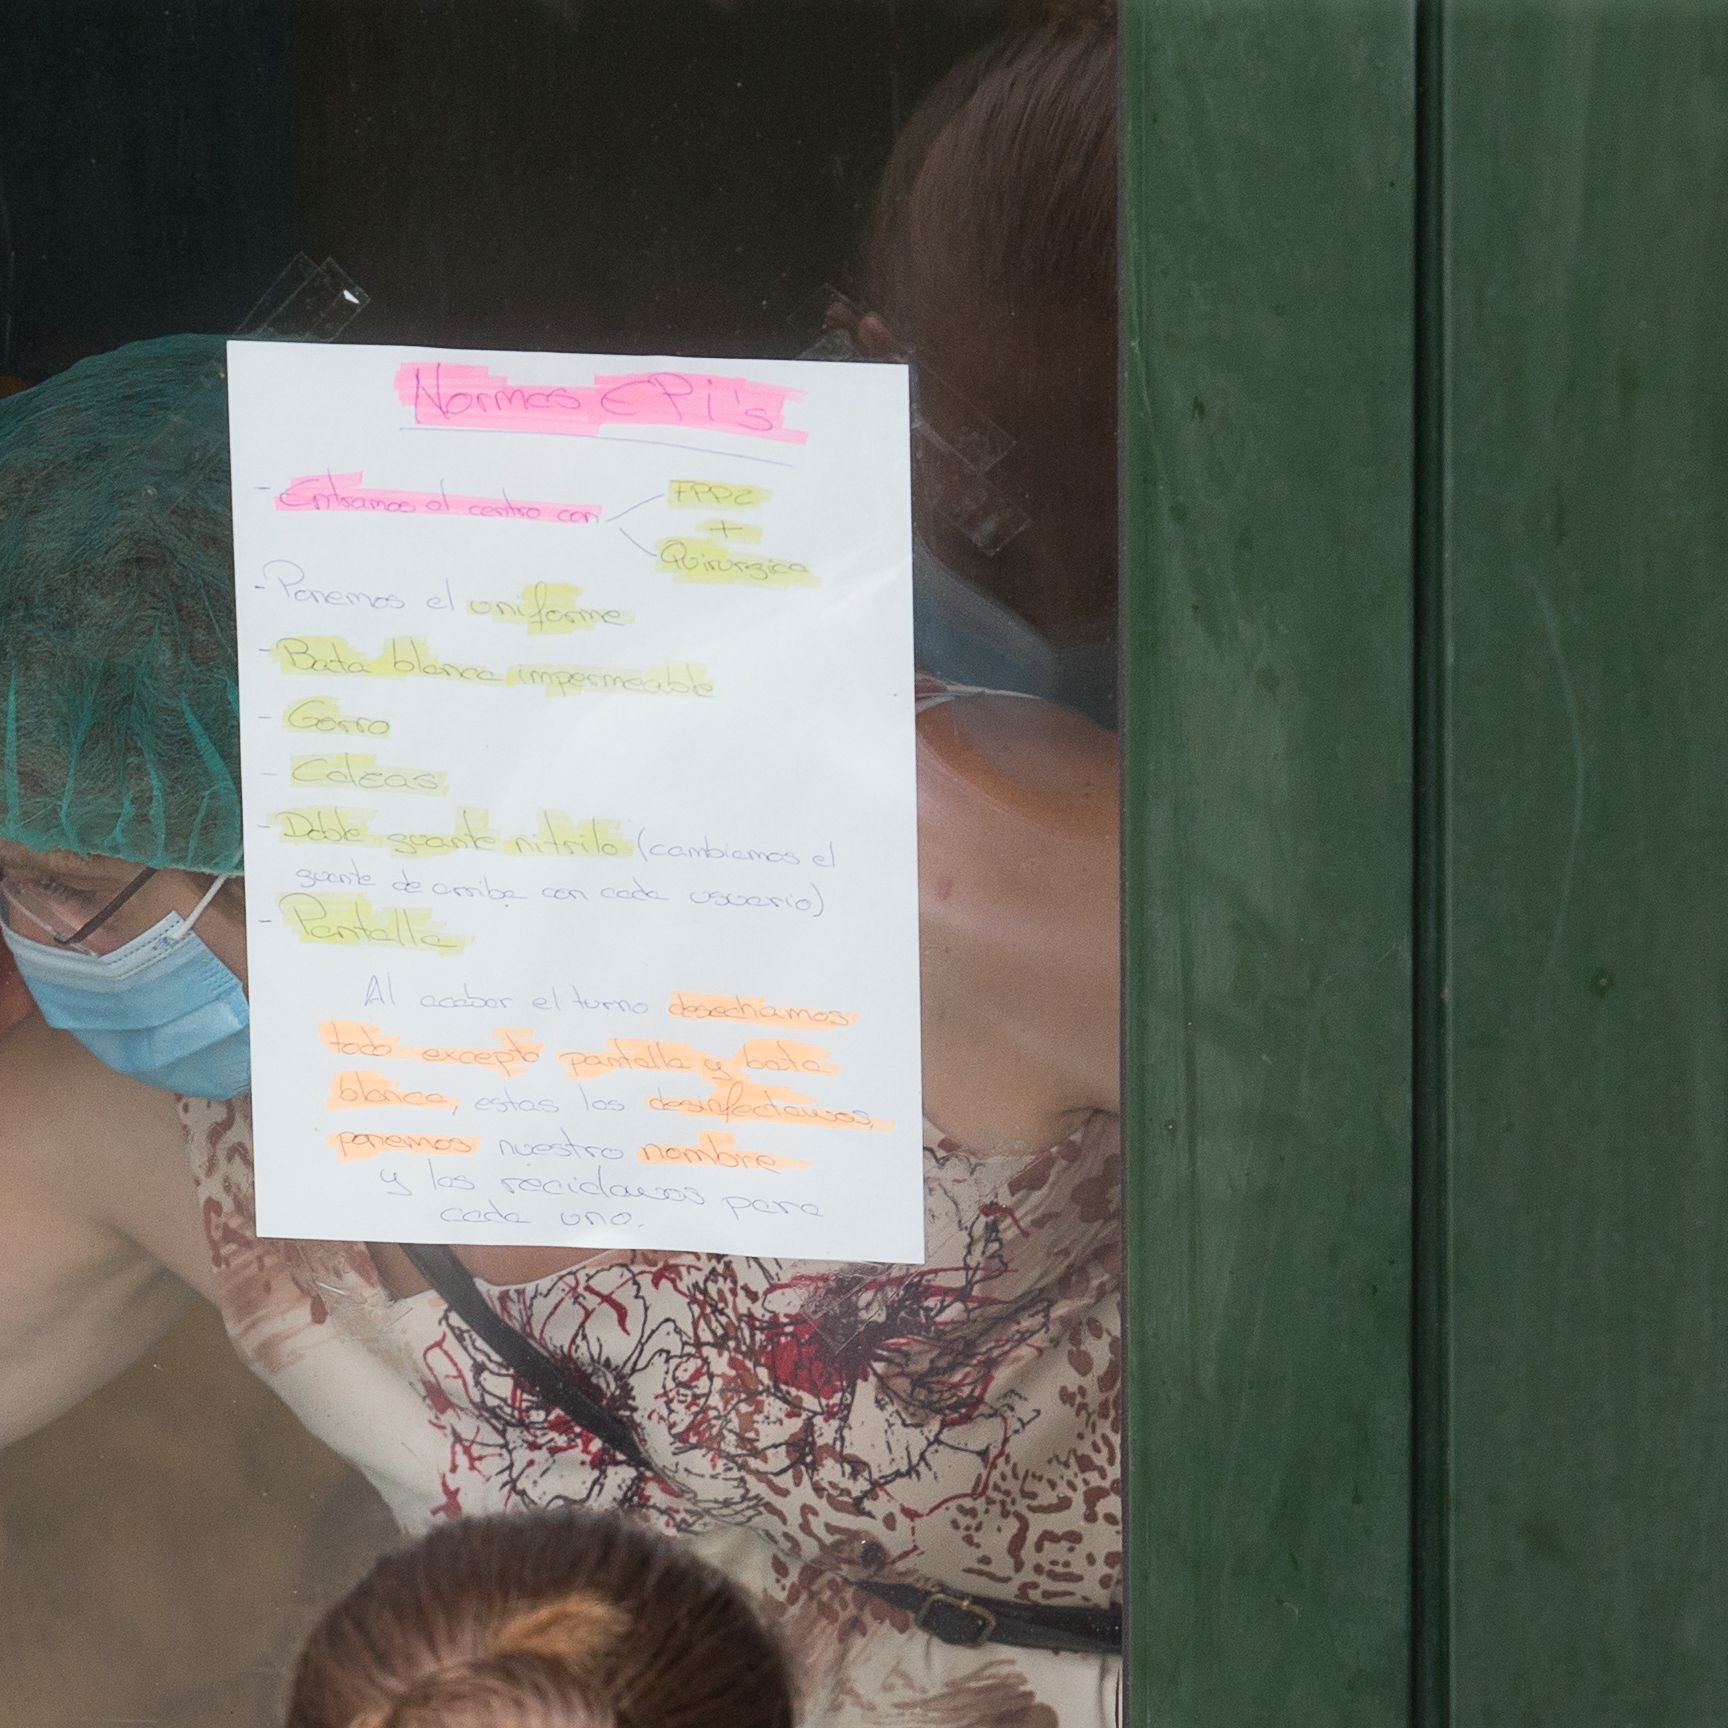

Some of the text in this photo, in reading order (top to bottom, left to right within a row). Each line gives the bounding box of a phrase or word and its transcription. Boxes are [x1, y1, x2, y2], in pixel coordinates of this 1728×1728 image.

[413, 368, 581, 424] Normas
[278, 468, 414, 514] Entramos
[468, 489, 541, 524] centro
[558, 506, 600, 524] con
[261, 560, 627, 631] Ponemos el uniforme
[276, 636, 714, 699] Bata blanca impermeable
[287, 700, 390, 735] Gorro
[283, 809, 836, 868] Doble guante nitrilo (cambiamos el
[296, 866, 825, 919] guante de arriba con cada usuario)
[278, 893, 458, 951] Pantalla
[363, 974, 851, 1029] Al acabar el turno desechamos
[328, 1026, 830, 1078] todo excepto pantalla y bata
[338, 1083, 459, 1116] blanca,
[475, 1093, 559, 1114] estas
[585, 1089, 627, 1115] las
[335, 1130, 781, 1170] ponemos nuestro nombre
[380, 1167, 411, 1196] y
[724, 1193, 825, 1219] para
[440, 1205, 531, 1226] cada
